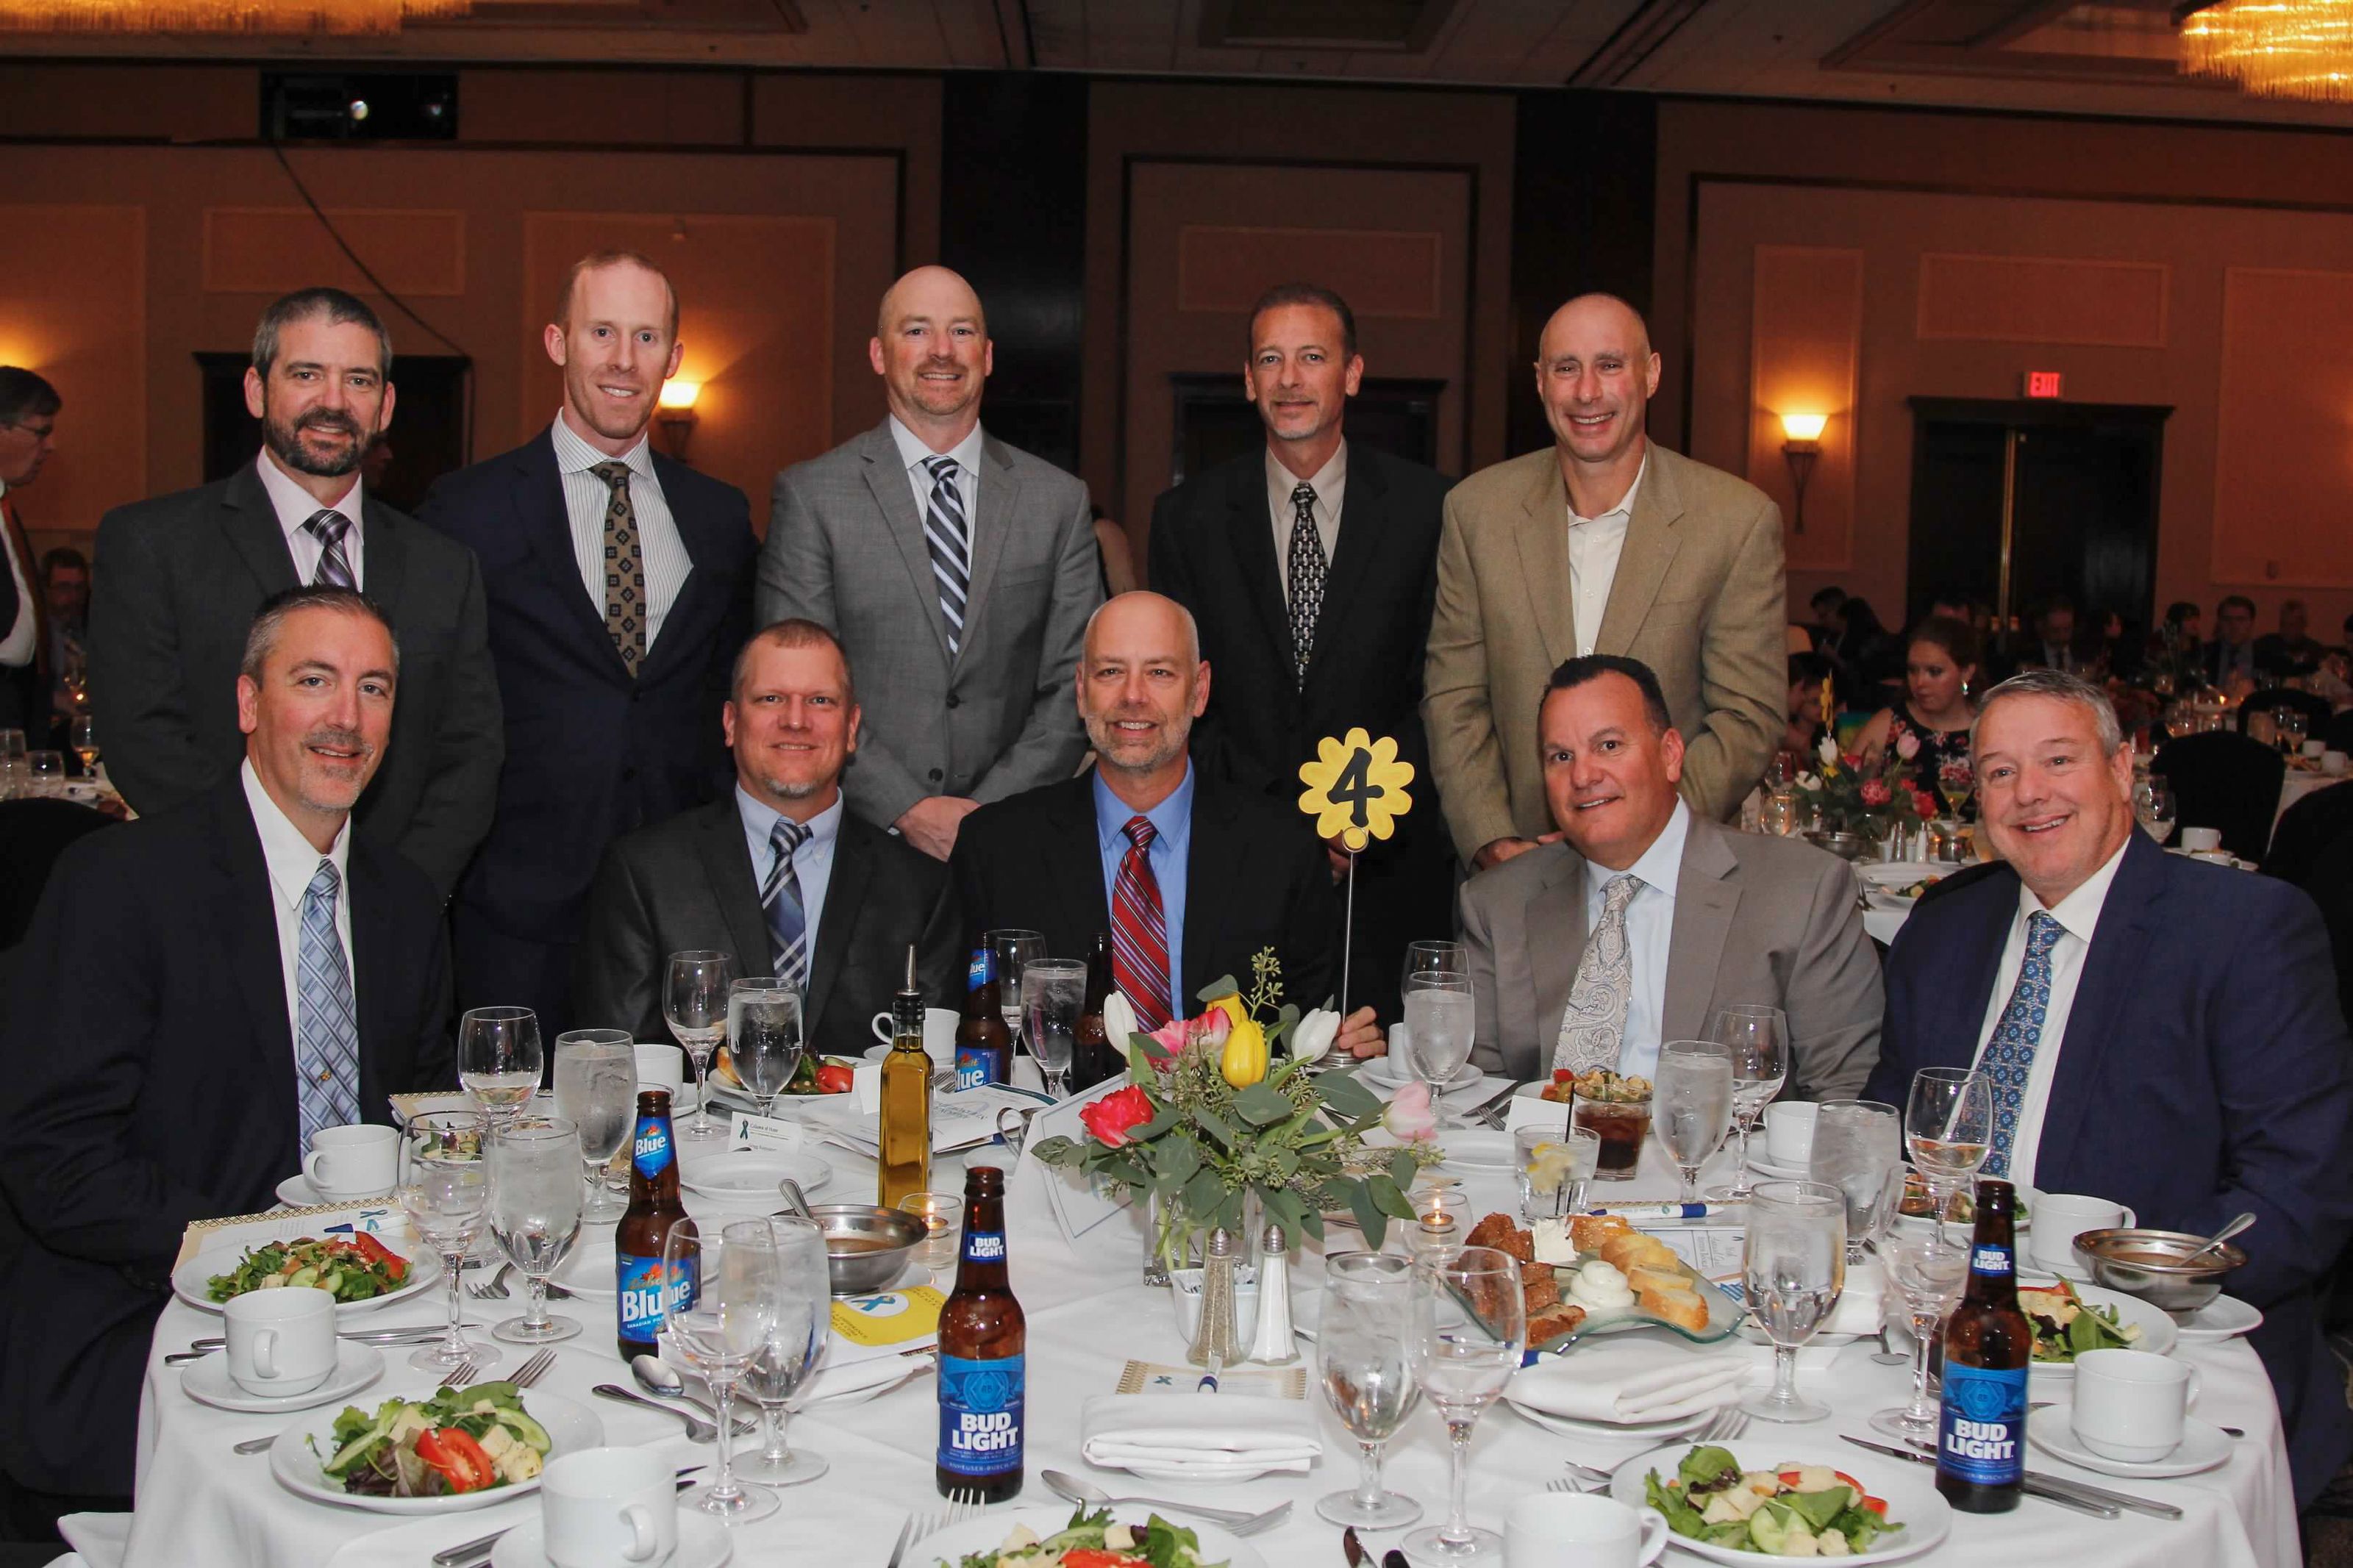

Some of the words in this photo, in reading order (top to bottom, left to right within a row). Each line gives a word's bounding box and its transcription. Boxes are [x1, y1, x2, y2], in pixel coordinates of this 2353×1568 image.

[1327, 747, 1385, 828] 4
[969, 962, 986, 974] lue
[957, 1069, 985, 1090] lue
[635, 1136, 666, 1156] Blue
[970, 1245, 1004, 1257] LIGHT
[975, 1236, 1000, 1247] BUD
[1973, 1258, 2010, 1270] LIGHT
[1978, 1250, 2005, 1261] BUD
[960, 1411, 1012, 1433] BUD
[1954, 1417, 2007, 1442] BUD
[952, 1426, 1018, 1452] LIGHT
[1946, 1433, 2015, 1459] LIGHT
